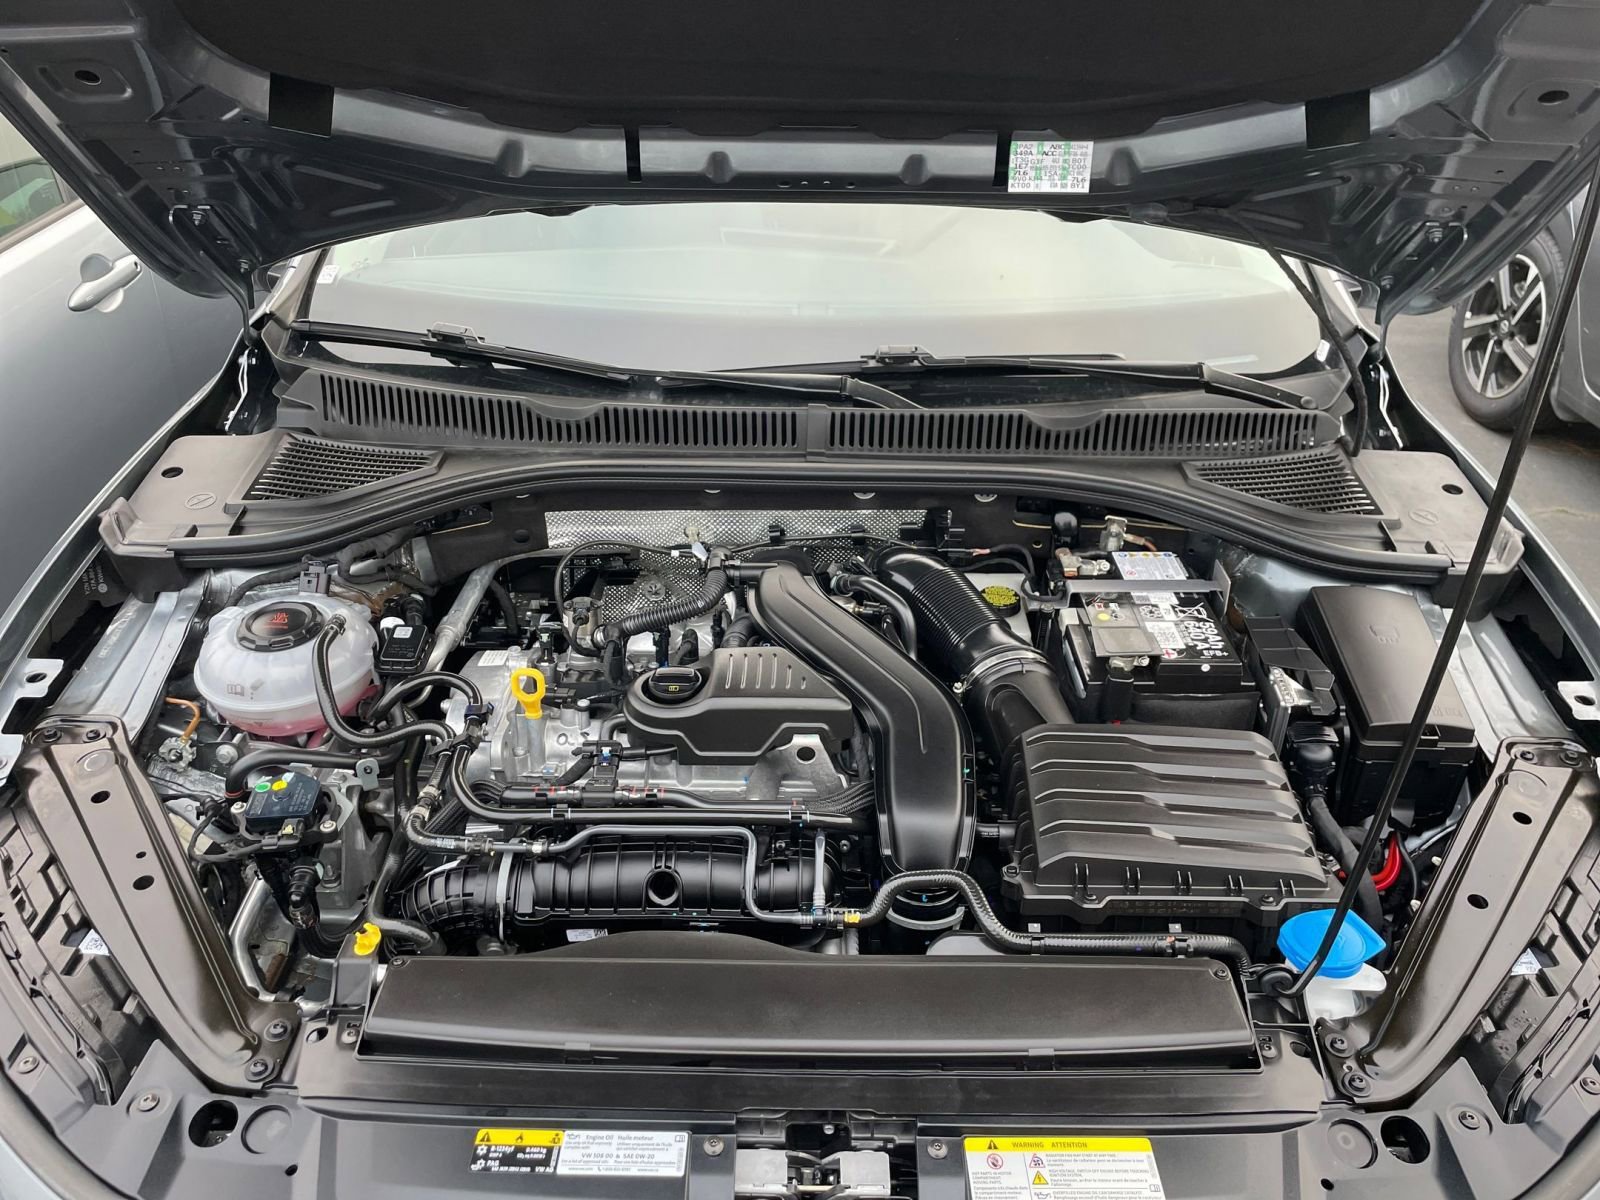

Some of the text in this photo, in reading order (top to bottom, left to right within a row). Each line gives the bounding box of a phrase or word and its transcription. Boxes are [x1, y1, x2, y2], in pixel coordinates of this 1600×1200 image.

[1183, 620, 1206, 640] 640
[1199, 621, 1225, 649] 59Ah
[1193, 640, 1212, 650] A
